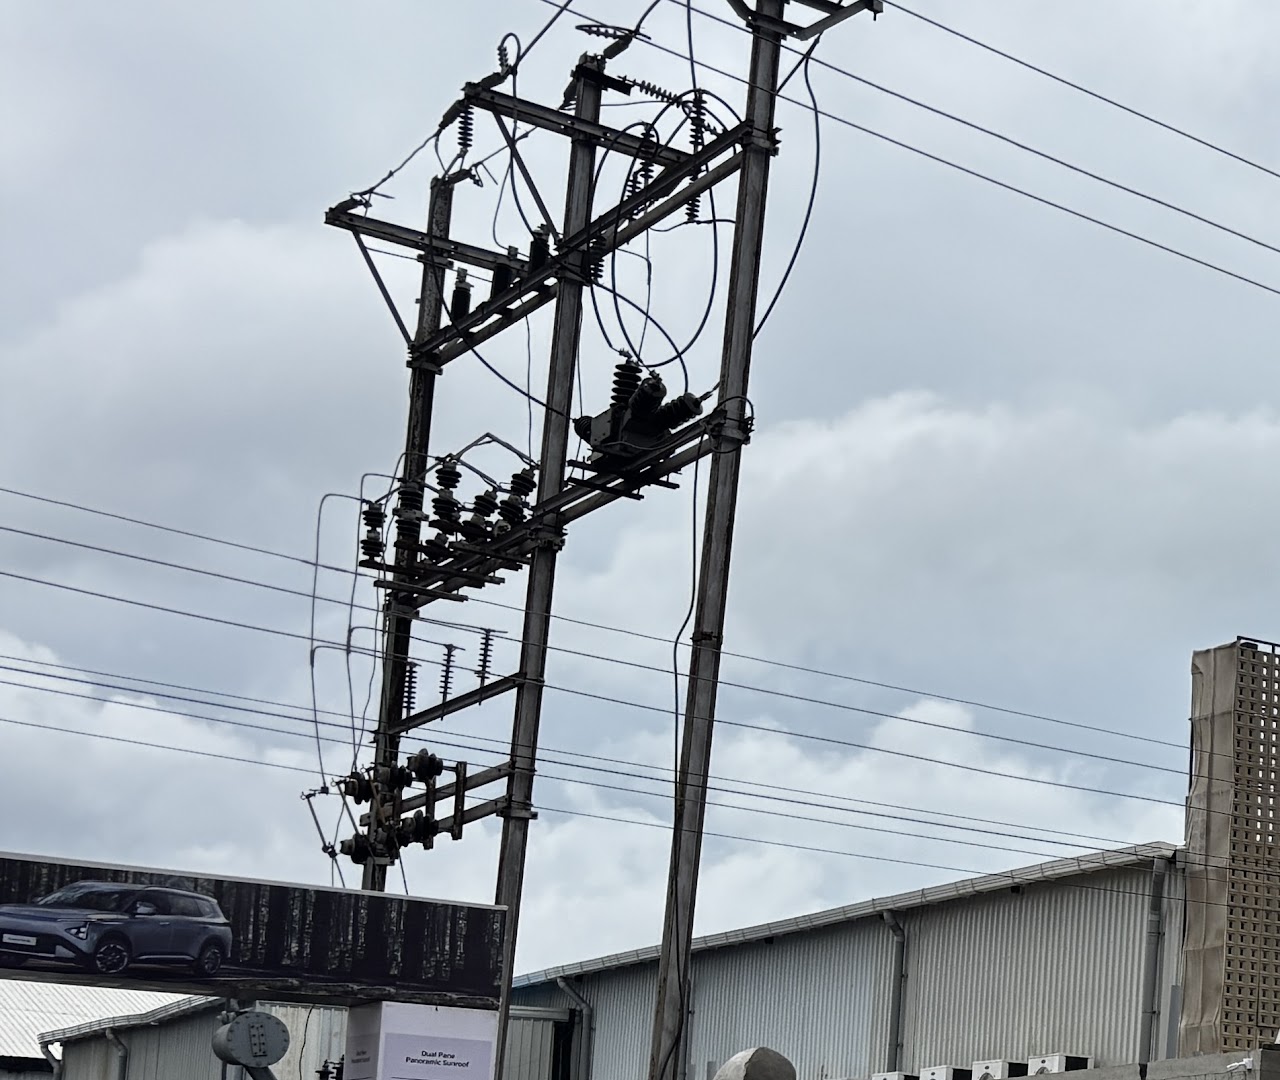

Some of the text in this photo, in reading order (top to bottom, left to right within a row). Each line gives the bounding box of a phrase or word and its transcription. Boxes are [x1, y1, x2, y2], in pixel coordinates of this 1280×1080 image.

[421, 1050, 455, 1059] Dual Pane
[405, 1056, 470, 1068] Panoramic Sunroof
